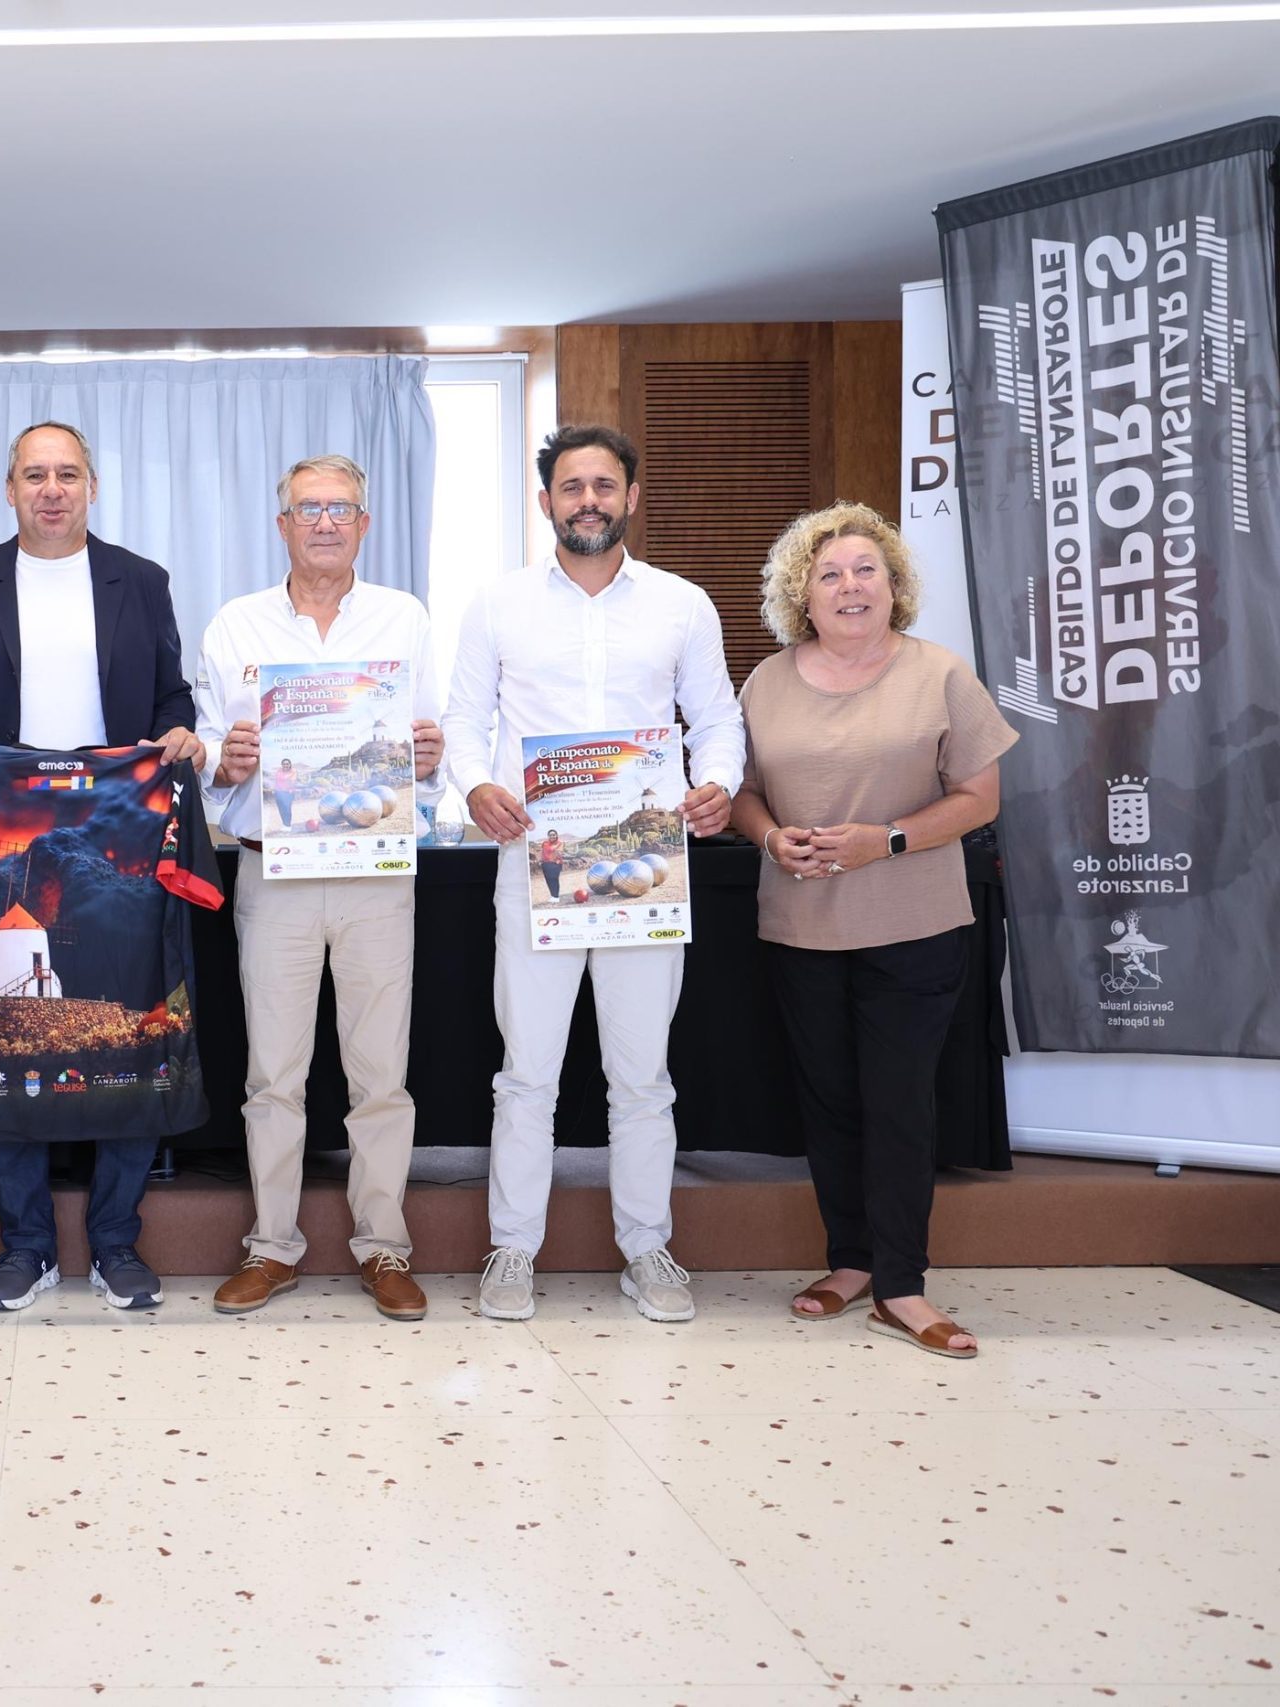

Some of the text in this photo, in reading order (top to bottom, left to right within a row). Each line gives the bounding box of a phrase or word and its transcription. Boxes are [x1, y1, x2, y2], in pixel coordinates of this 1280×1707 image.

[273, 675, 355, 689] Campeonato
[272, 691, 283, 700] de
[274, 702, 328, 714] Petanca
[537, 728, 669, 760] Campeonato FEP
[536, 759, 614, 773] de España de
[538, 773, 595, 785] Petanca
[655, 930, 678, 938] OBUT
[93, 1077, 138, 1085] LANZAROTE
